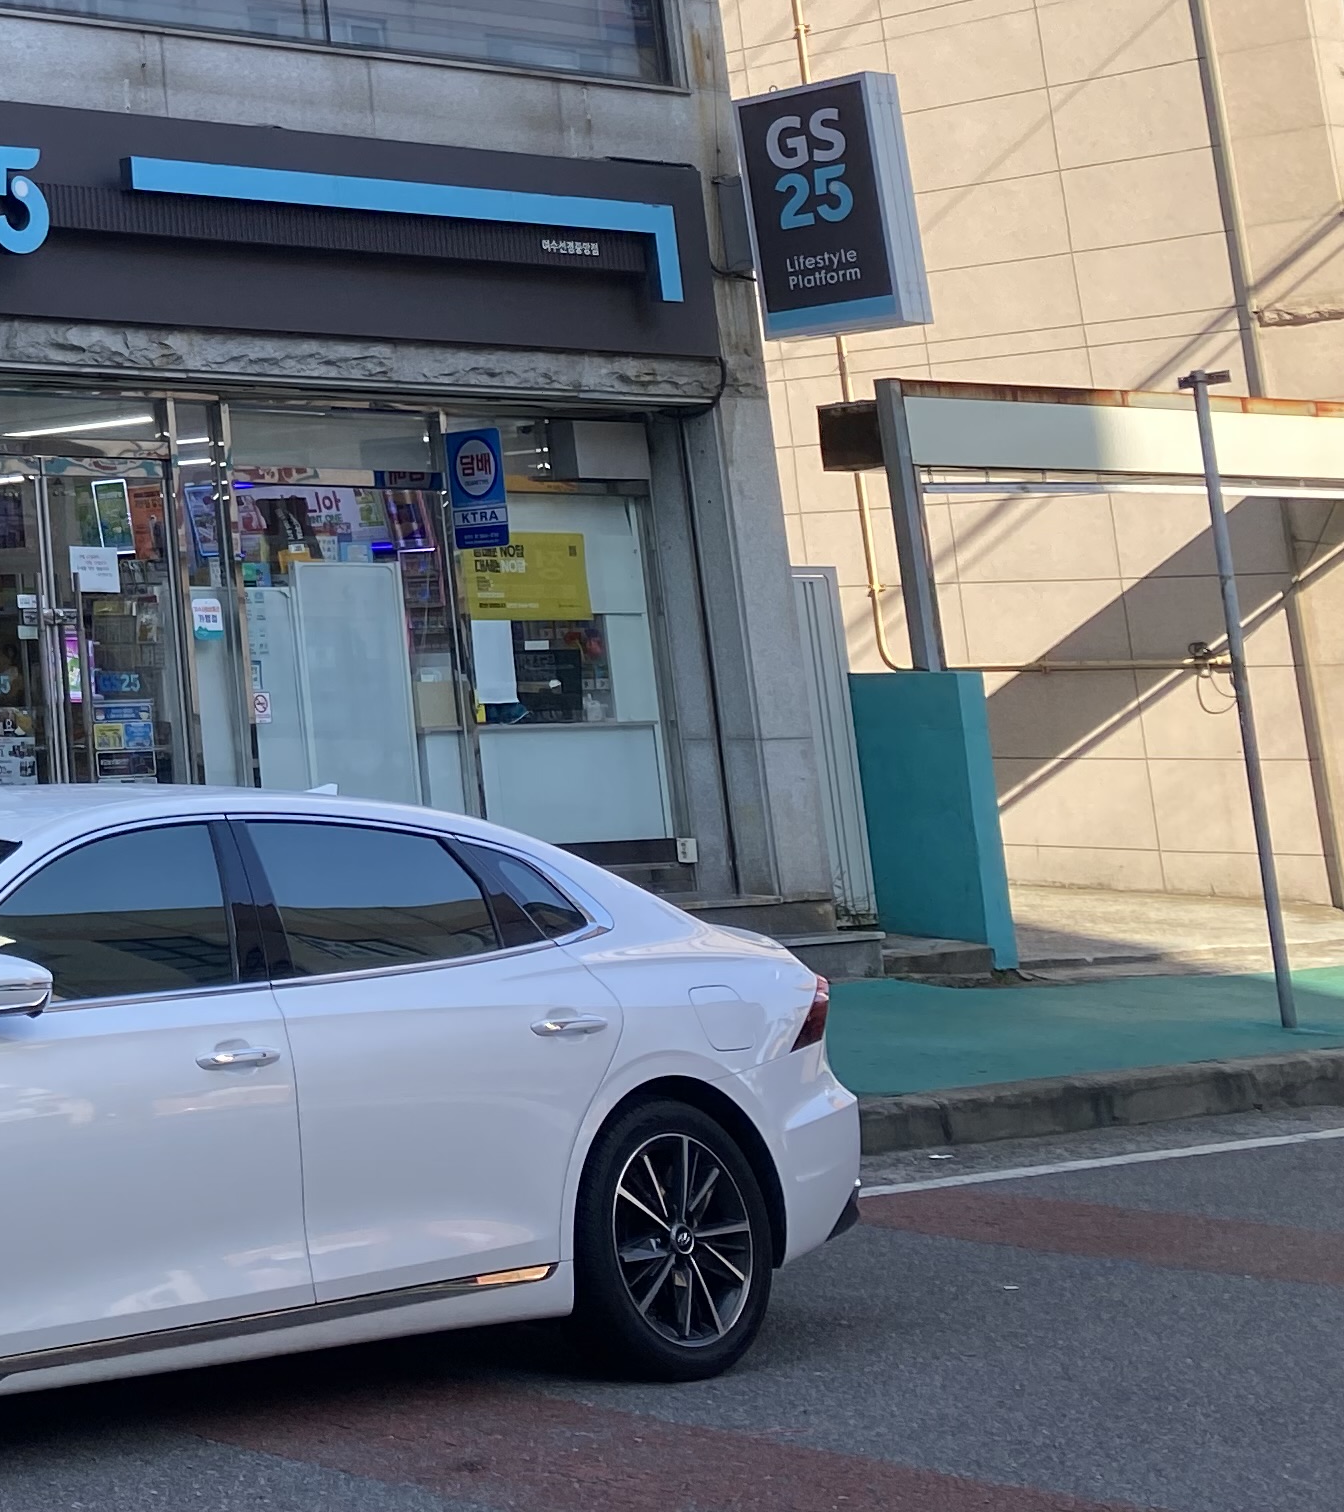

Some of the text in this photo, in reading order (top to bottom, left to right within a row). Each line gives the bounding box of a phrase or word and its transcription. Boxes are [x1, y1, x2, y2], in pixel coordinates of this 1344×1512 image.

[765, 107, 847, 170] GS
[774, 163, 854, 231] 25
[786, 247, 858, 273] Lifestyle
[788, 266, 862, 291] Platform
[459, 452, 492, 477] 담배
[461, 510, 499, 524] KTRA
